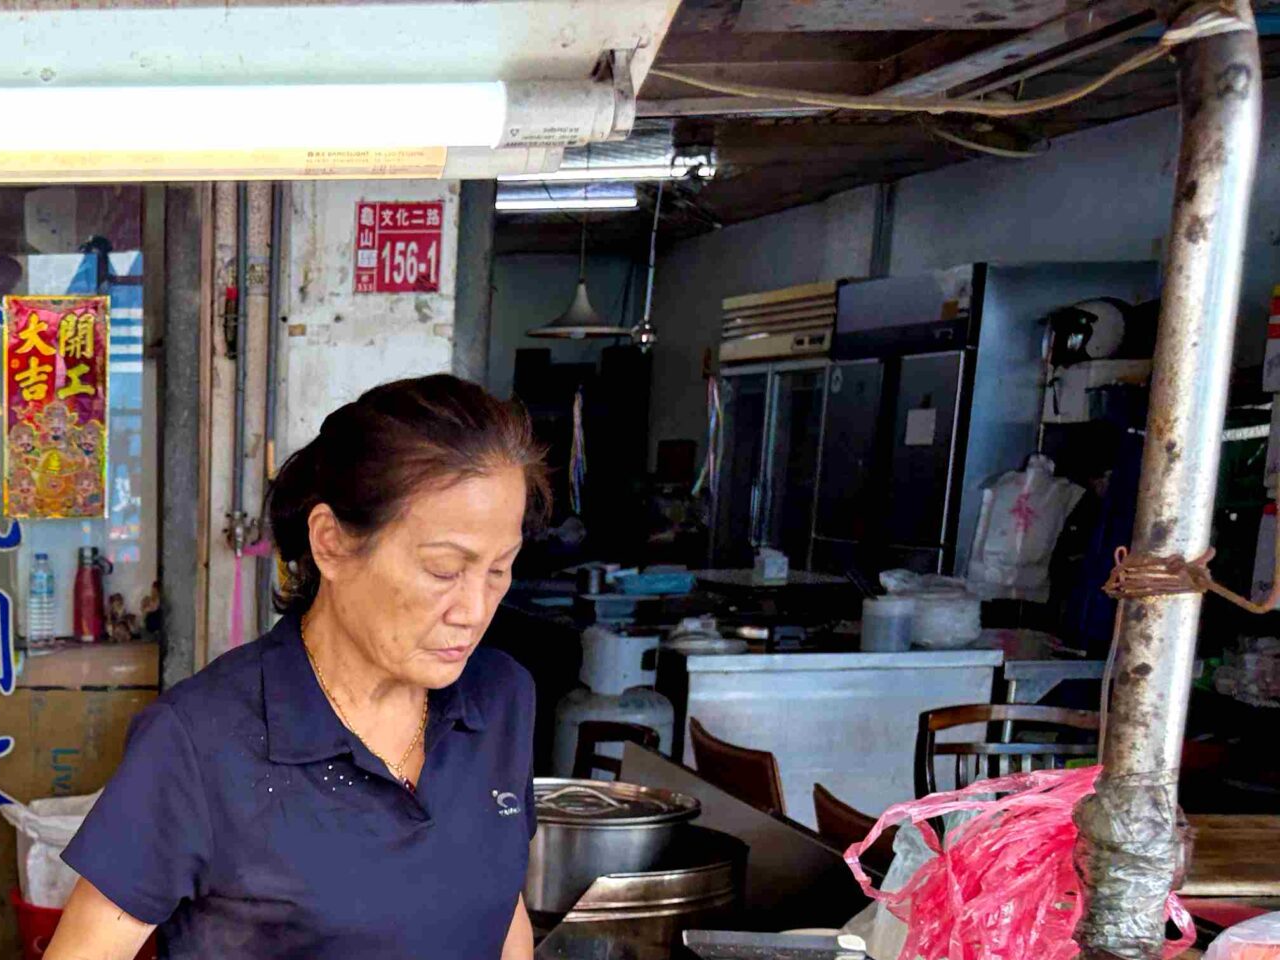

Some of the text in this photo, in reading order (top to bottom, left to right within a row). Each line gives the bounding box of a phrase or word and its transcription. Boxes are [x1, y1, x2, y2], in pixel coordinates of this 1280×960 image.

[380, 207, 440, 227] 文化二路
[381, 240, 438, 285] 156-1
[14, 311, 57, 401] 大吉
[57, 312, 96, 400] 開工
